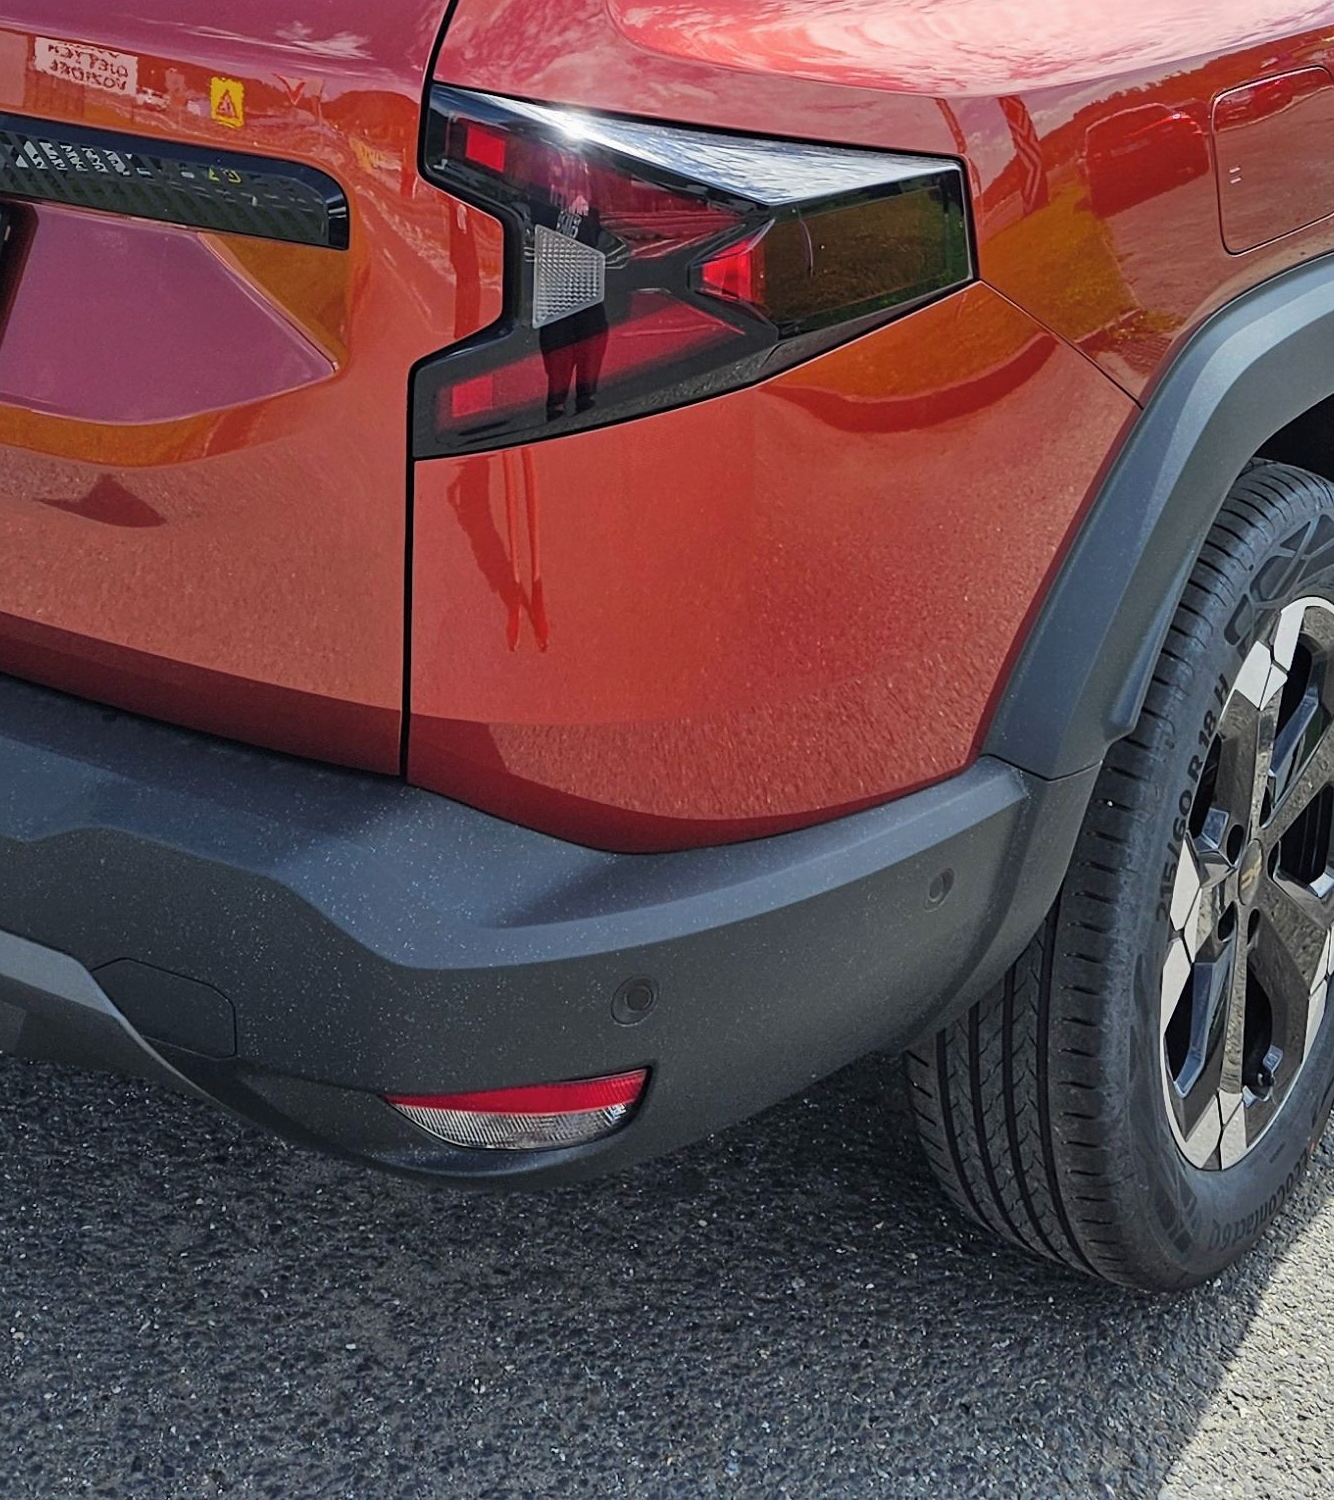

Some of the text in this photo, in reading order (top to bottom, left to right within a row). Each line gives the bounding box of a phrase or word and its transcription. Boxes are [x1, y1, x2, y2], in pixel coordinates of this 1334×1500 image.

[1187, 754, 1204, 784] R
[1199, 709, 1217, 750] 18
[1214, 673, 1230, 707] H
